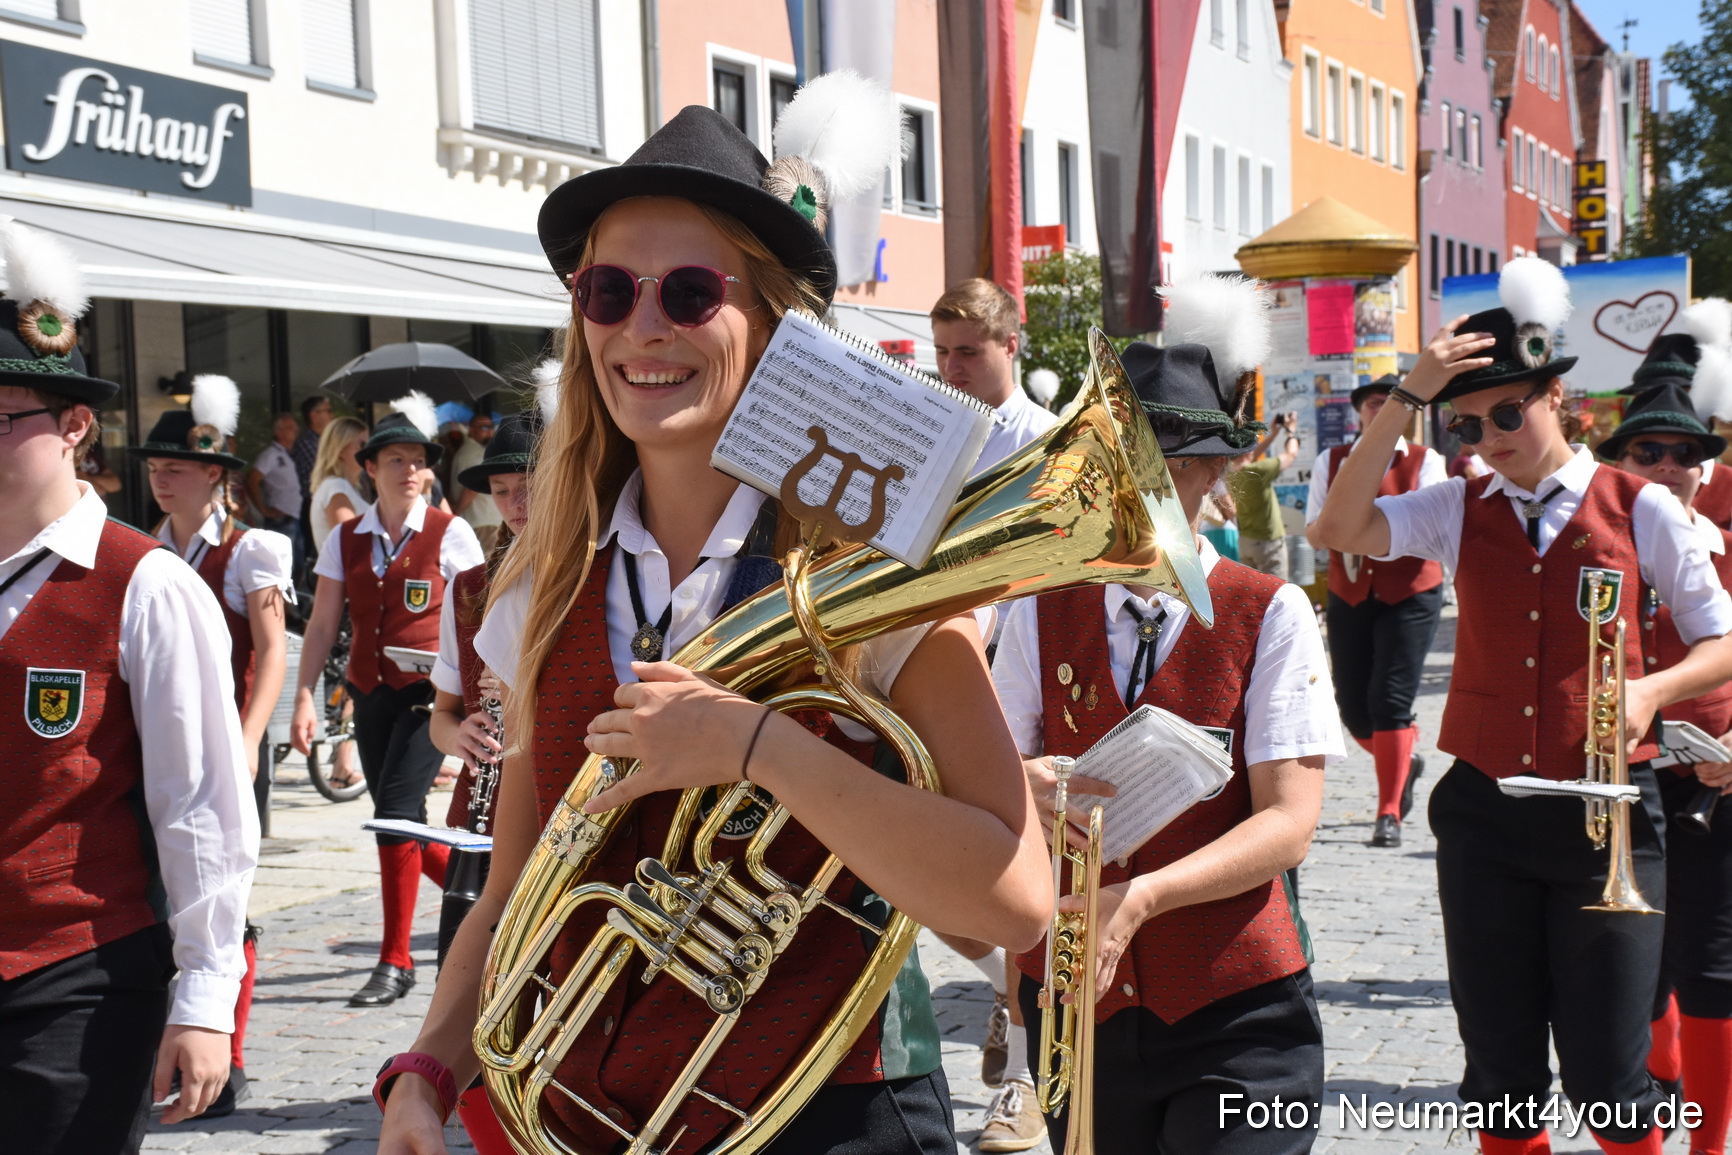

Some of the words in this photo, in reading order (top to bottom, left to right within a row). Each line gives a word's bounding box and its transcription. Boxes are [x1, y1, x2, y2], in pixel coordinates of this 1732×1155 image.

[22, 67, 245, 188] frühauf
[845, 350, 858, 362] Ins
[857, 357, 877, 371] Land
[876, 366, 904, 386] hinaus
[30, 674, 81, 684] BLASKAPELLE
[31, 717, 73, 734] PILSACH
